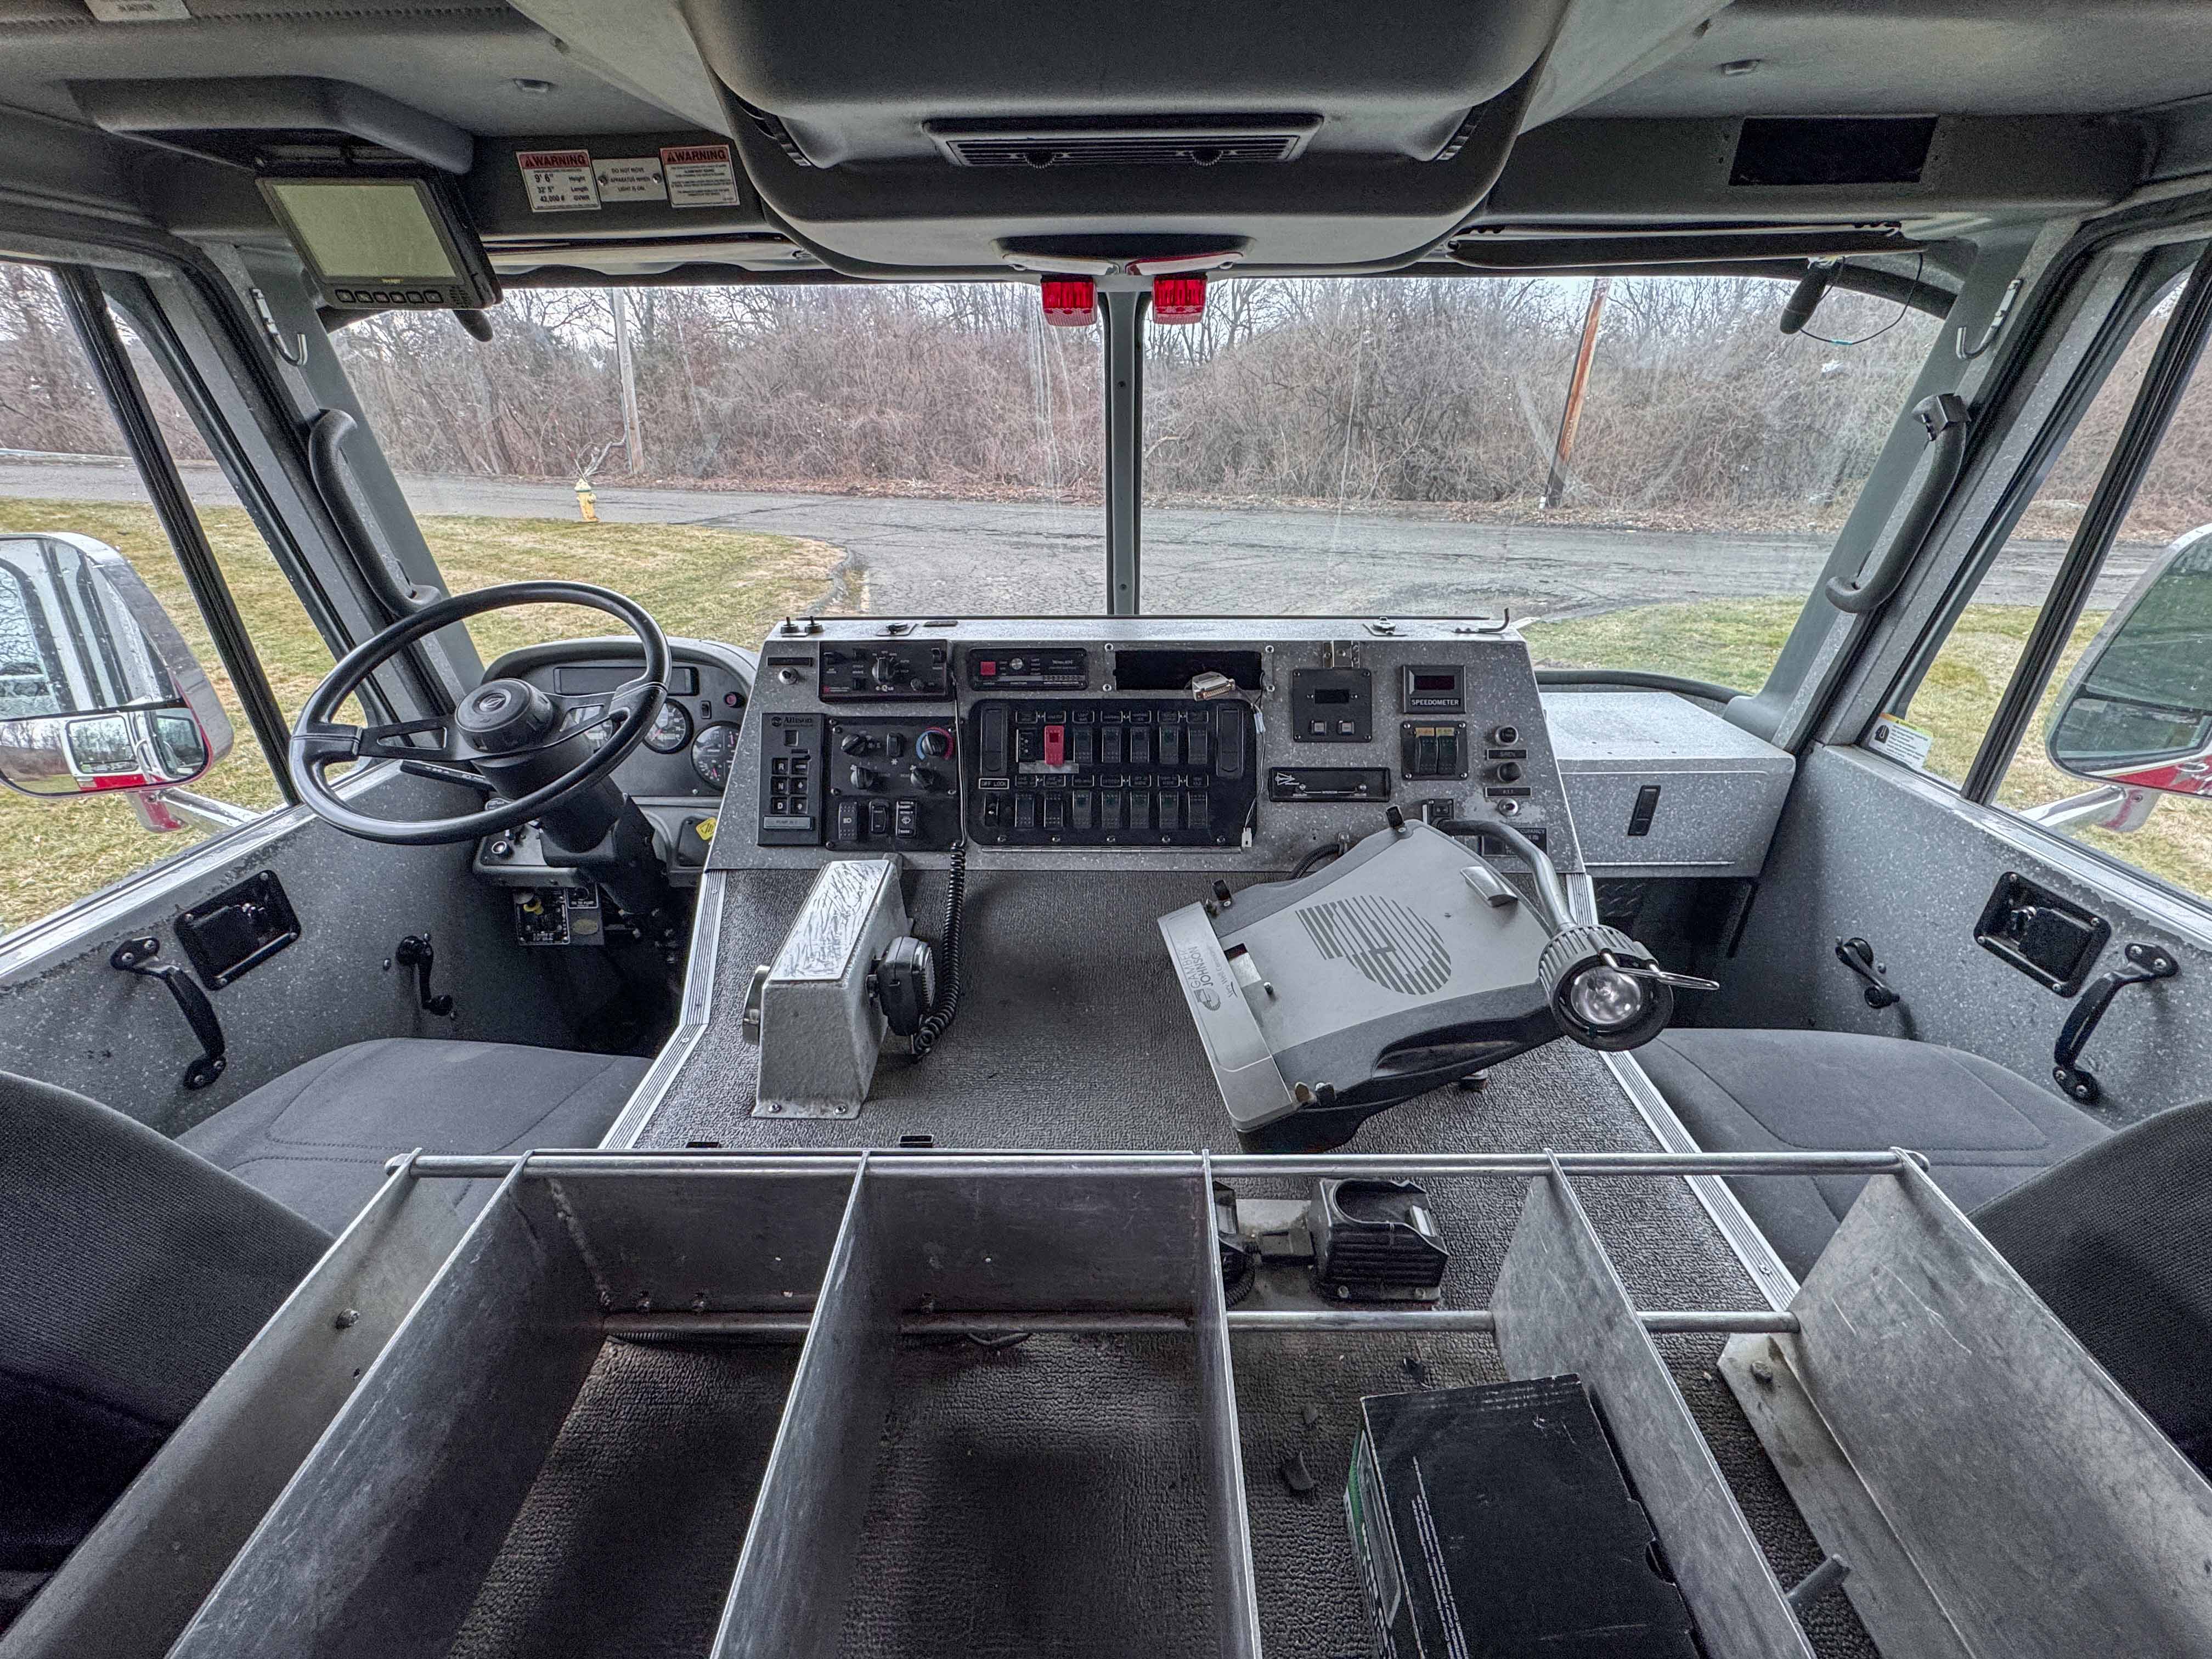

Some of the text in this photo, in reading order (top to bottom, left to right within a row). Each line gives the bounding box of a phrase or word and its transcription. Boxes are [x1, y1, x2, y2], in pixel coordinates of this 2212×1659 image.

[533, 155, 585, 166] WARNING
[675, 150, 726, 161] WARNING
[1179, 949, 1201, 988] GAMBER
[1188, 946, 1214, 986] JOHNSON
